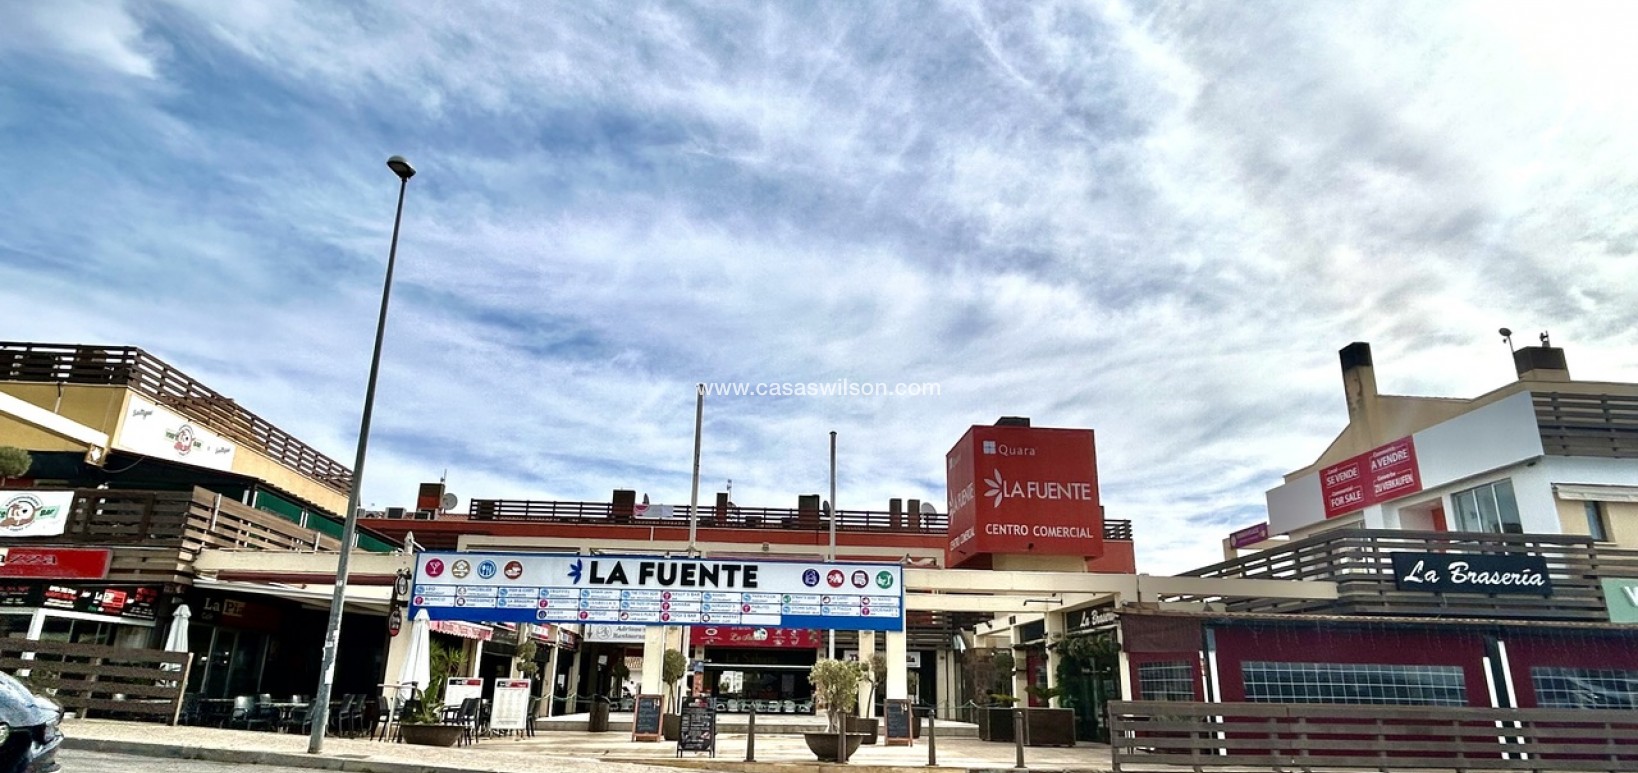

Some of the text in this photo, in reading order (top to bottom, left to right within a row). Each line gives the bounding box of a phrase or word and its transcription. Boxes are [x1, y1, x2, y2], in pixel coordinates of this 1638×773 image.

[998, 444, 1036, 457] Quara
[1377, 449, 1408, 468] VENDRE
[1326, 467, 1358, 486] SE VENDE
[1381, 473, 1413, 492] VERKAUFEN
[1003, 480, 1092, 501] LA FUENTE
[1331, 490, 1362, 508] FOR SALE
[985, 523, 1094, 539] CENTRO COMERCIAL
[589, 560, 758, 588] LA FUENTE
[1403, 560, 1440, 584] La
[202, 597, 220, 612] La
